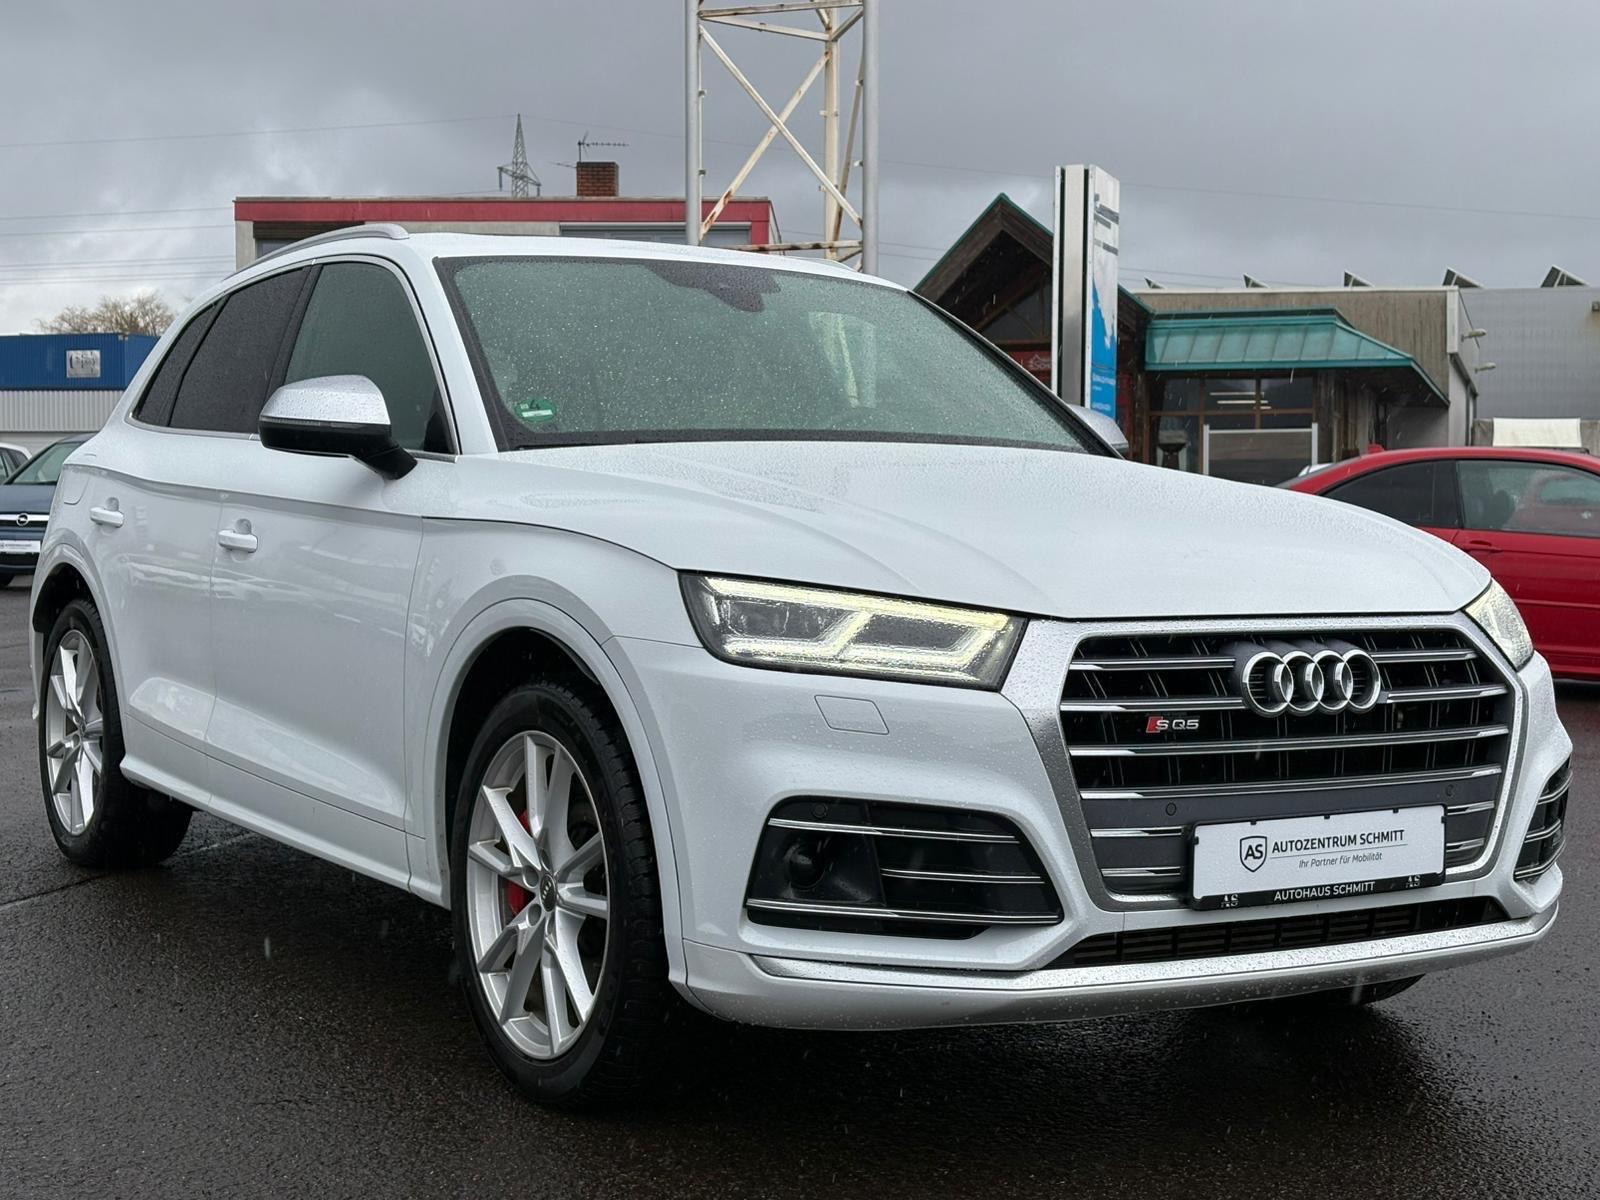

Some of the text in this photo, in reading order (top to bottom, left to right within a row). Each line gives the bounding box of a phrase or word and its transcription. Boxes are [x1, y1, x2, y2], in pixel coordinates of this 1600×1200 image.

[1153, 718, 1200, 731] SQ5
[1271, 829, 1405, 854] AUTOZENTRUM SCHMITT
[1244, 844, 1264, 861] AS
[1299, 852, 1382, 868] Ihr Partner für Mobilität
[1274, 881, 1375, 902] AUTOHAUS SCHMITT
